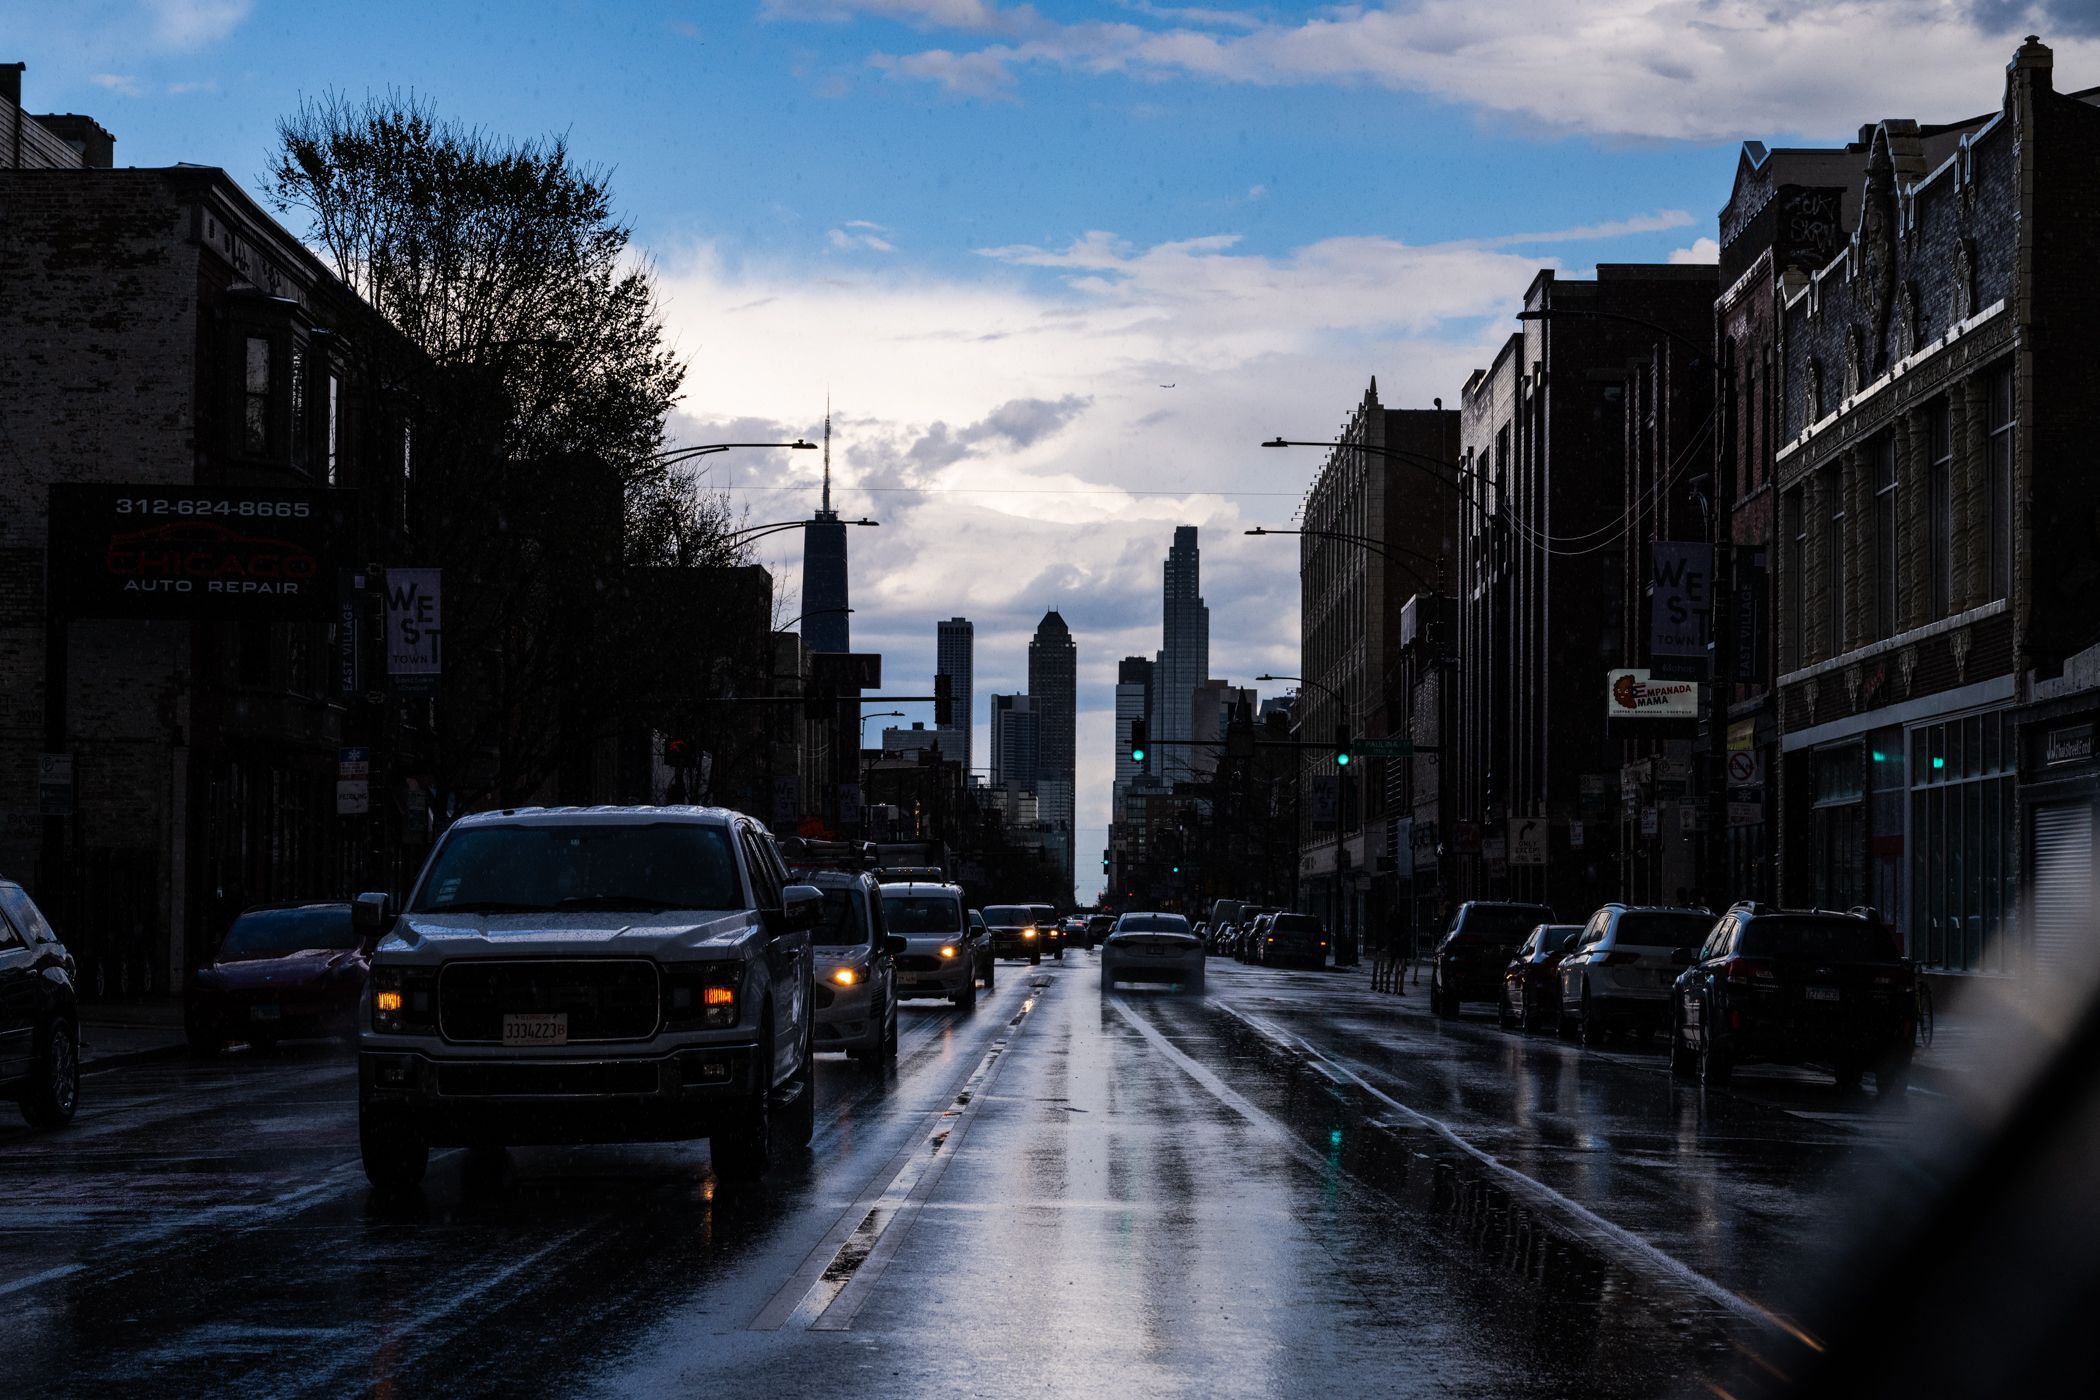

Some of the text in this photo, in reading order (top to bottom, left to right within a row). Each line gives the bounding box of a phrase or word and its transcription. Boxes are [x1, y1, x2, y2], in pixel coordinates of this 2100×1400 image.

[115, 498, 310, 518] 312-624-8665
[106, 549, 318, 580] CHICAGO
[123, 579, 299, 595] AUTO REPAIR
[1738, 584, 1754, 678] EAST VILLAGE
[342, 602, 353, 693] EAST VILLAGE
[1656, 634, 1695, 646] TOWN
[393, 655, 428, 665] TOWN
[1634, 683, 1692, 699] EMPANADA
[1637, 696, 1669, 707] MAMA
